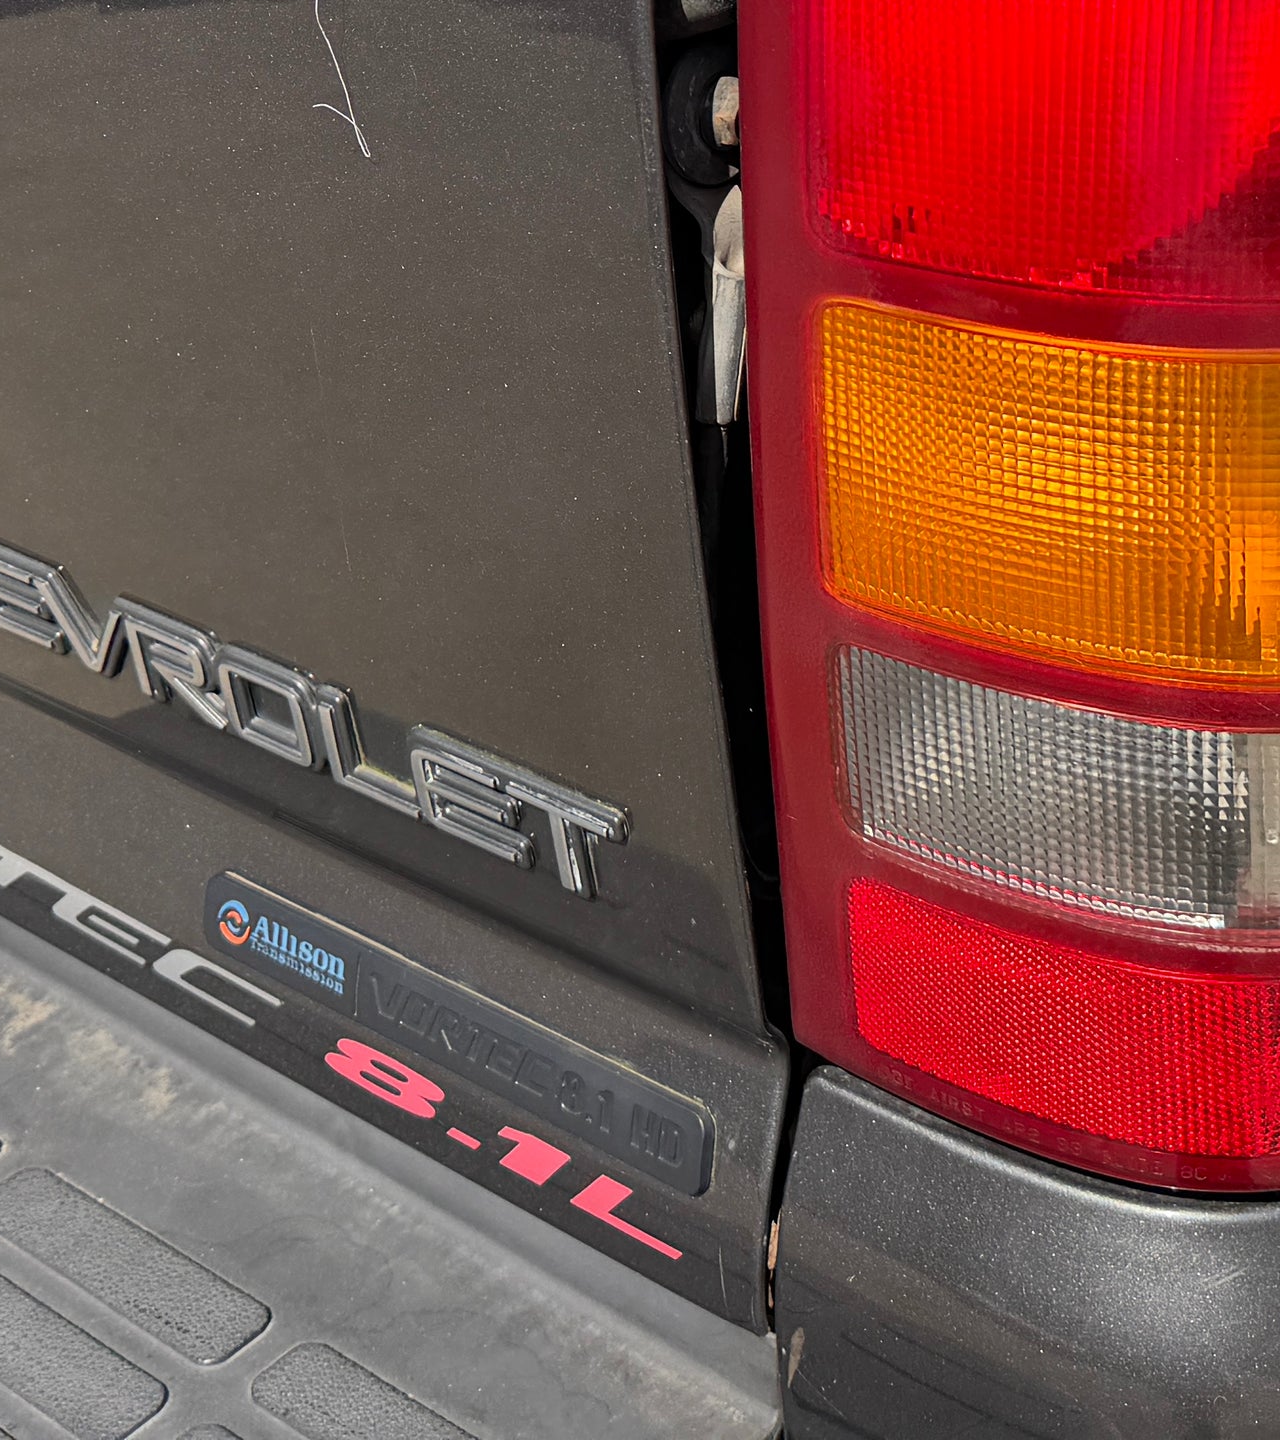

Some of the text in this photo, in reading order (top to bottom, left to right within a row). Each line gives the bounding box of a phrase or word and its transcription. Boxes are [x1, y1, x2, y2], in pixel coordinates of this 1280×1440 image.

[249, 937, 345, 996] Transmission
[251, 915, 346, 981] Allison
[370, 974, 554, 1099] VORTEC
[629, 1103, 684, 1169] HD
[324, 1037, 683, 1260] 8.1L
